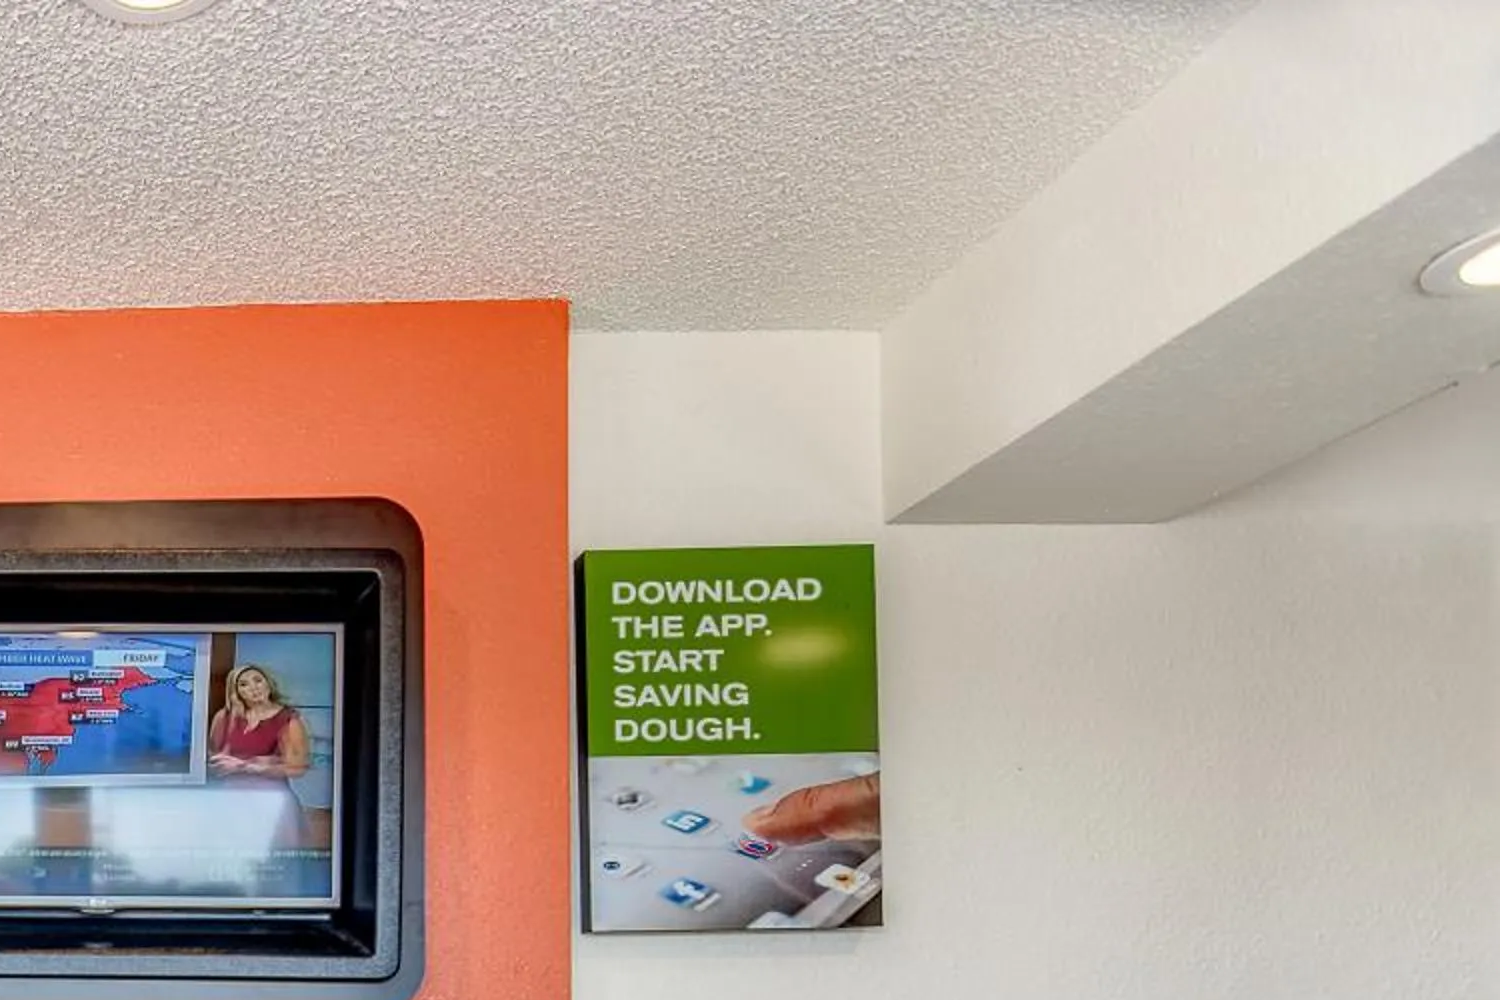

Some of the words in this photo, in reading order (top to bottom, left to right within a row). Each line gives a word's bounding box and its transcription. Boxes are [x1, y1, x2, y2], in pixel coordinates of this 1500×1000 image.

[611, 577, 822, 605] DOWNLOAD
[611, 615, 685, 639] THE
[695, 613, 772, 637] APP.
[122, 653, 159, 663] FRIDAY
[613, 649, 724, 673] START
[613, 683, 750, 709] SAVING
[614, 717, 761, 742] DOUGH.
